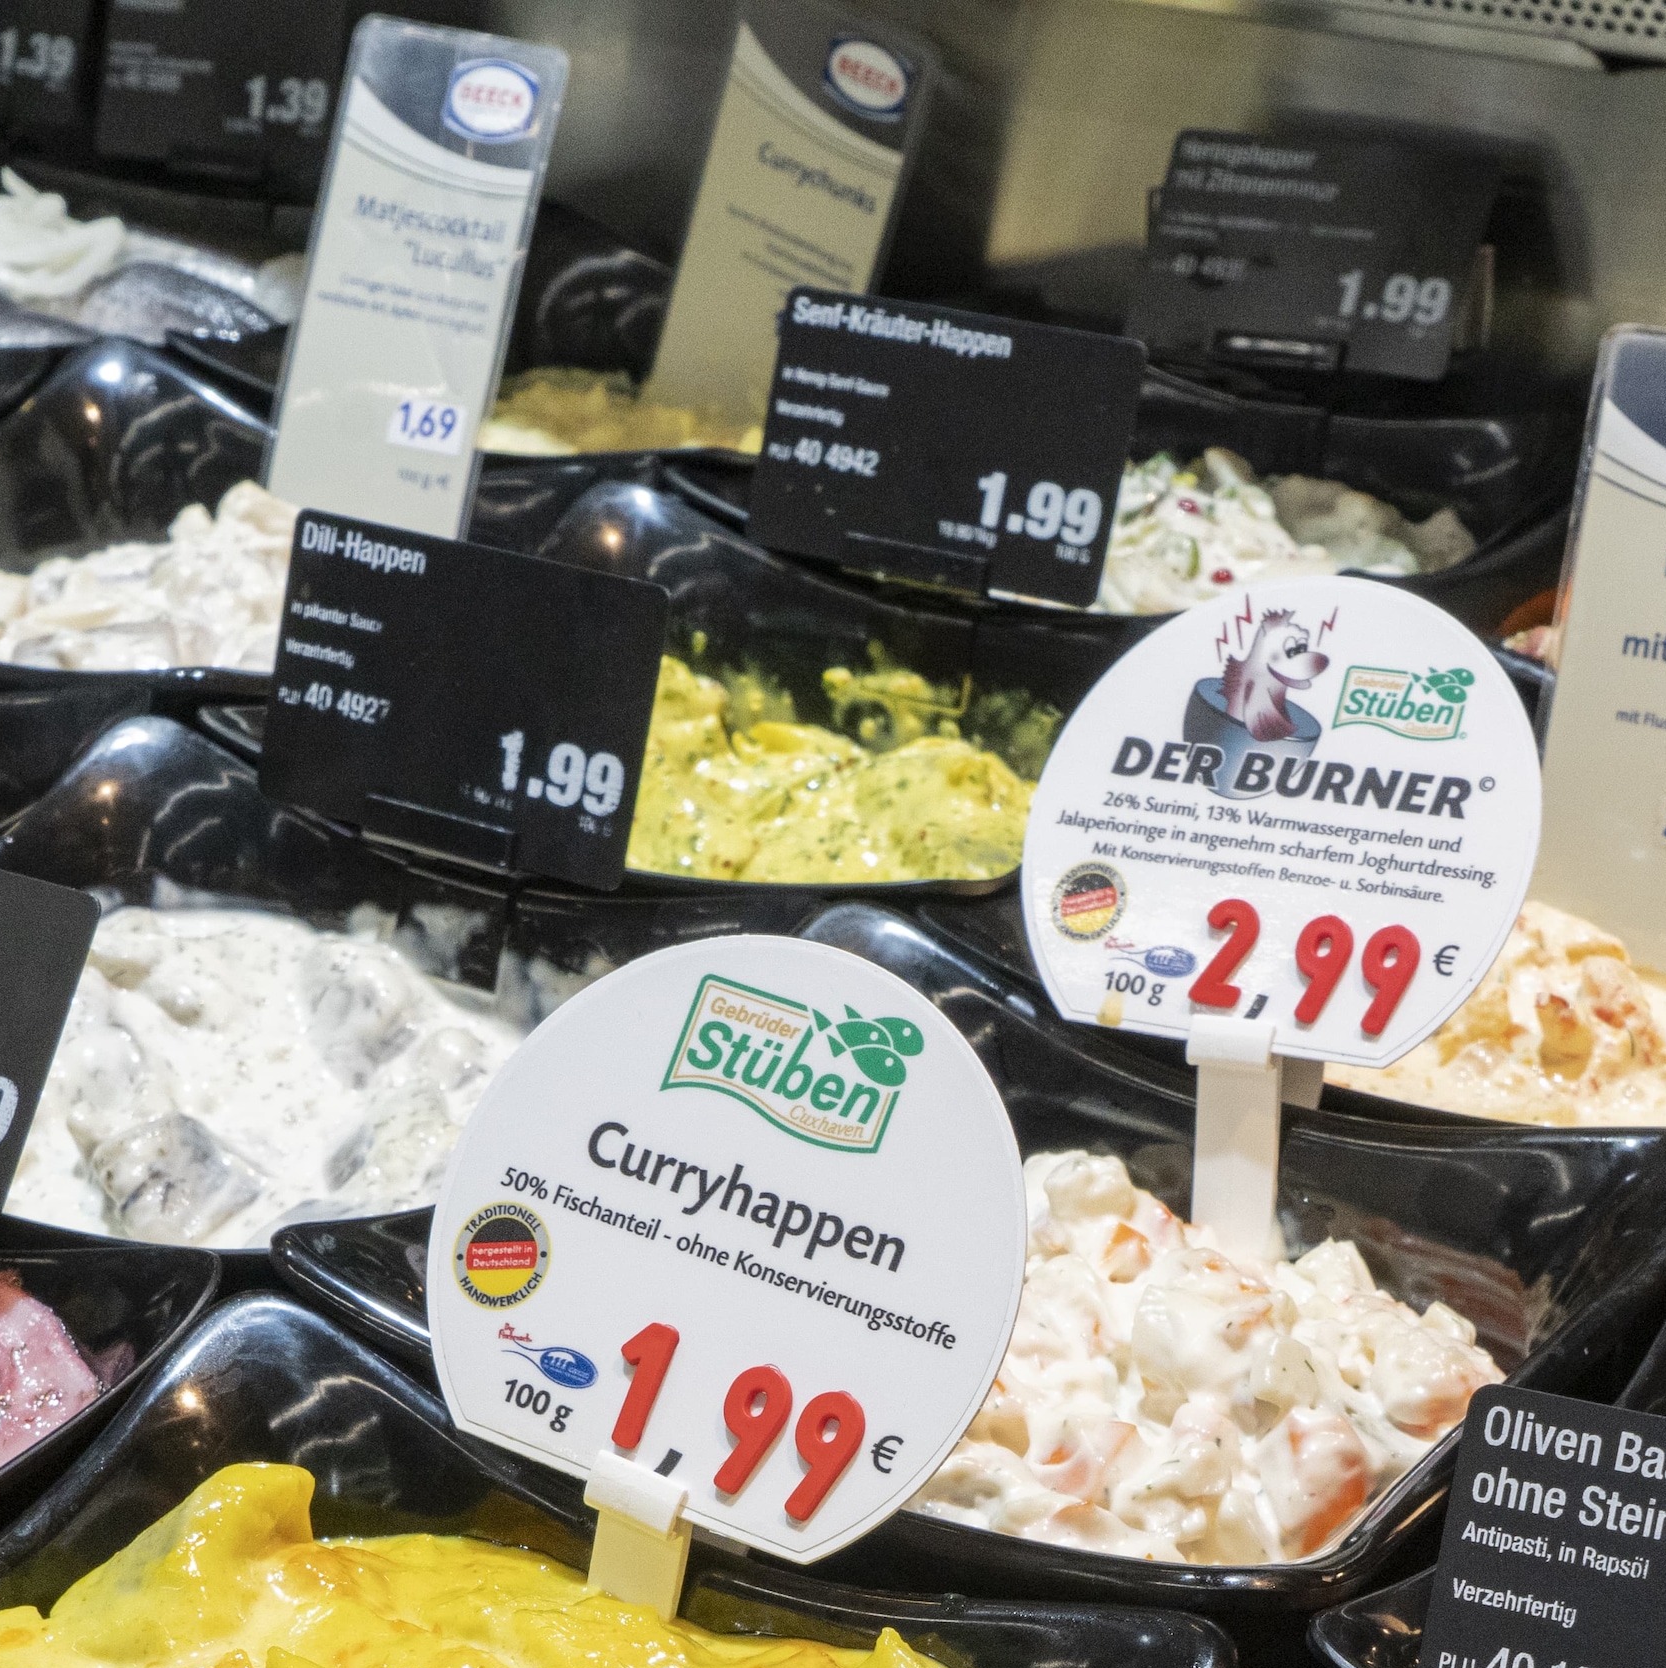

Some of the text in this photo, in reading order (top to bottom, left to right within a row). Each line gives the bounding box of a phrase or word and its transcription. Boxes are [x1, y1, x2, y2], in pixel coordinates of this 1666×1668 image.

[245, 76, 329, 123] 1.39
[832, 53, 903, 97] BEECK
[1338, 269, 1451, 324] 1.99
[793, 297, 1013, 359] Senf-Kräuter-Happen
[400, 401, 457, 441] 1,69
[794, 438, 880, 478] 40 4942
[978, 471, 1103, 547] 1.99
[301, 520, 427, 575] Dill-Happen
[305, 682, 333, 711] 40
[1343, 681, 1454, 725] Stüben
[499, 730, 625, 817] 1.99
[1111, 736, 1472, 820] DER BURNER
[1103, 791, 1423, 850] 26% Surimi, 13% Warmwassergarnelen
[1057, 810, 1498, 889] Jalapeñoringe angenehm scharfem Joghurtdressing.
[1120, 846, 1445, 904] Konservierungsstoffen Benzoe- Sorbinsäure.
[1104, 971, 1145, 995] 100
[1189, 898, 1420, 1036] 2,99
[1433, 945, 1460, 976] €
[710, 996, 801, 1039] Gebrüder
[687, 1021, 881, 1125] Stüben
[789, 1105, 864, 1138] Cuxhaven
[465, 1204, 541, 1234] TRADITIONELL
[586, 1121, 907, 1273] Curryhappen
[500, 1166, 957, 1351] 50% Fischanteil ohne Konservierungsstoffe
[459, 1272, 542, 1308] HANDWERKLICH
[505, 1379, 551, 1415] 100
[611, 1322, 866, 1524] 1,99
[870, 1434, 904, 1474] €
[1484, 1405, 1602, 1467] Oliven
[1472, 1466, 1567, 1519] ohne
[1461, 1520, 1650, 1579] Antipasti, Rapsöl
[1453, 1577, 1577, 1628] Verzehrfertig
